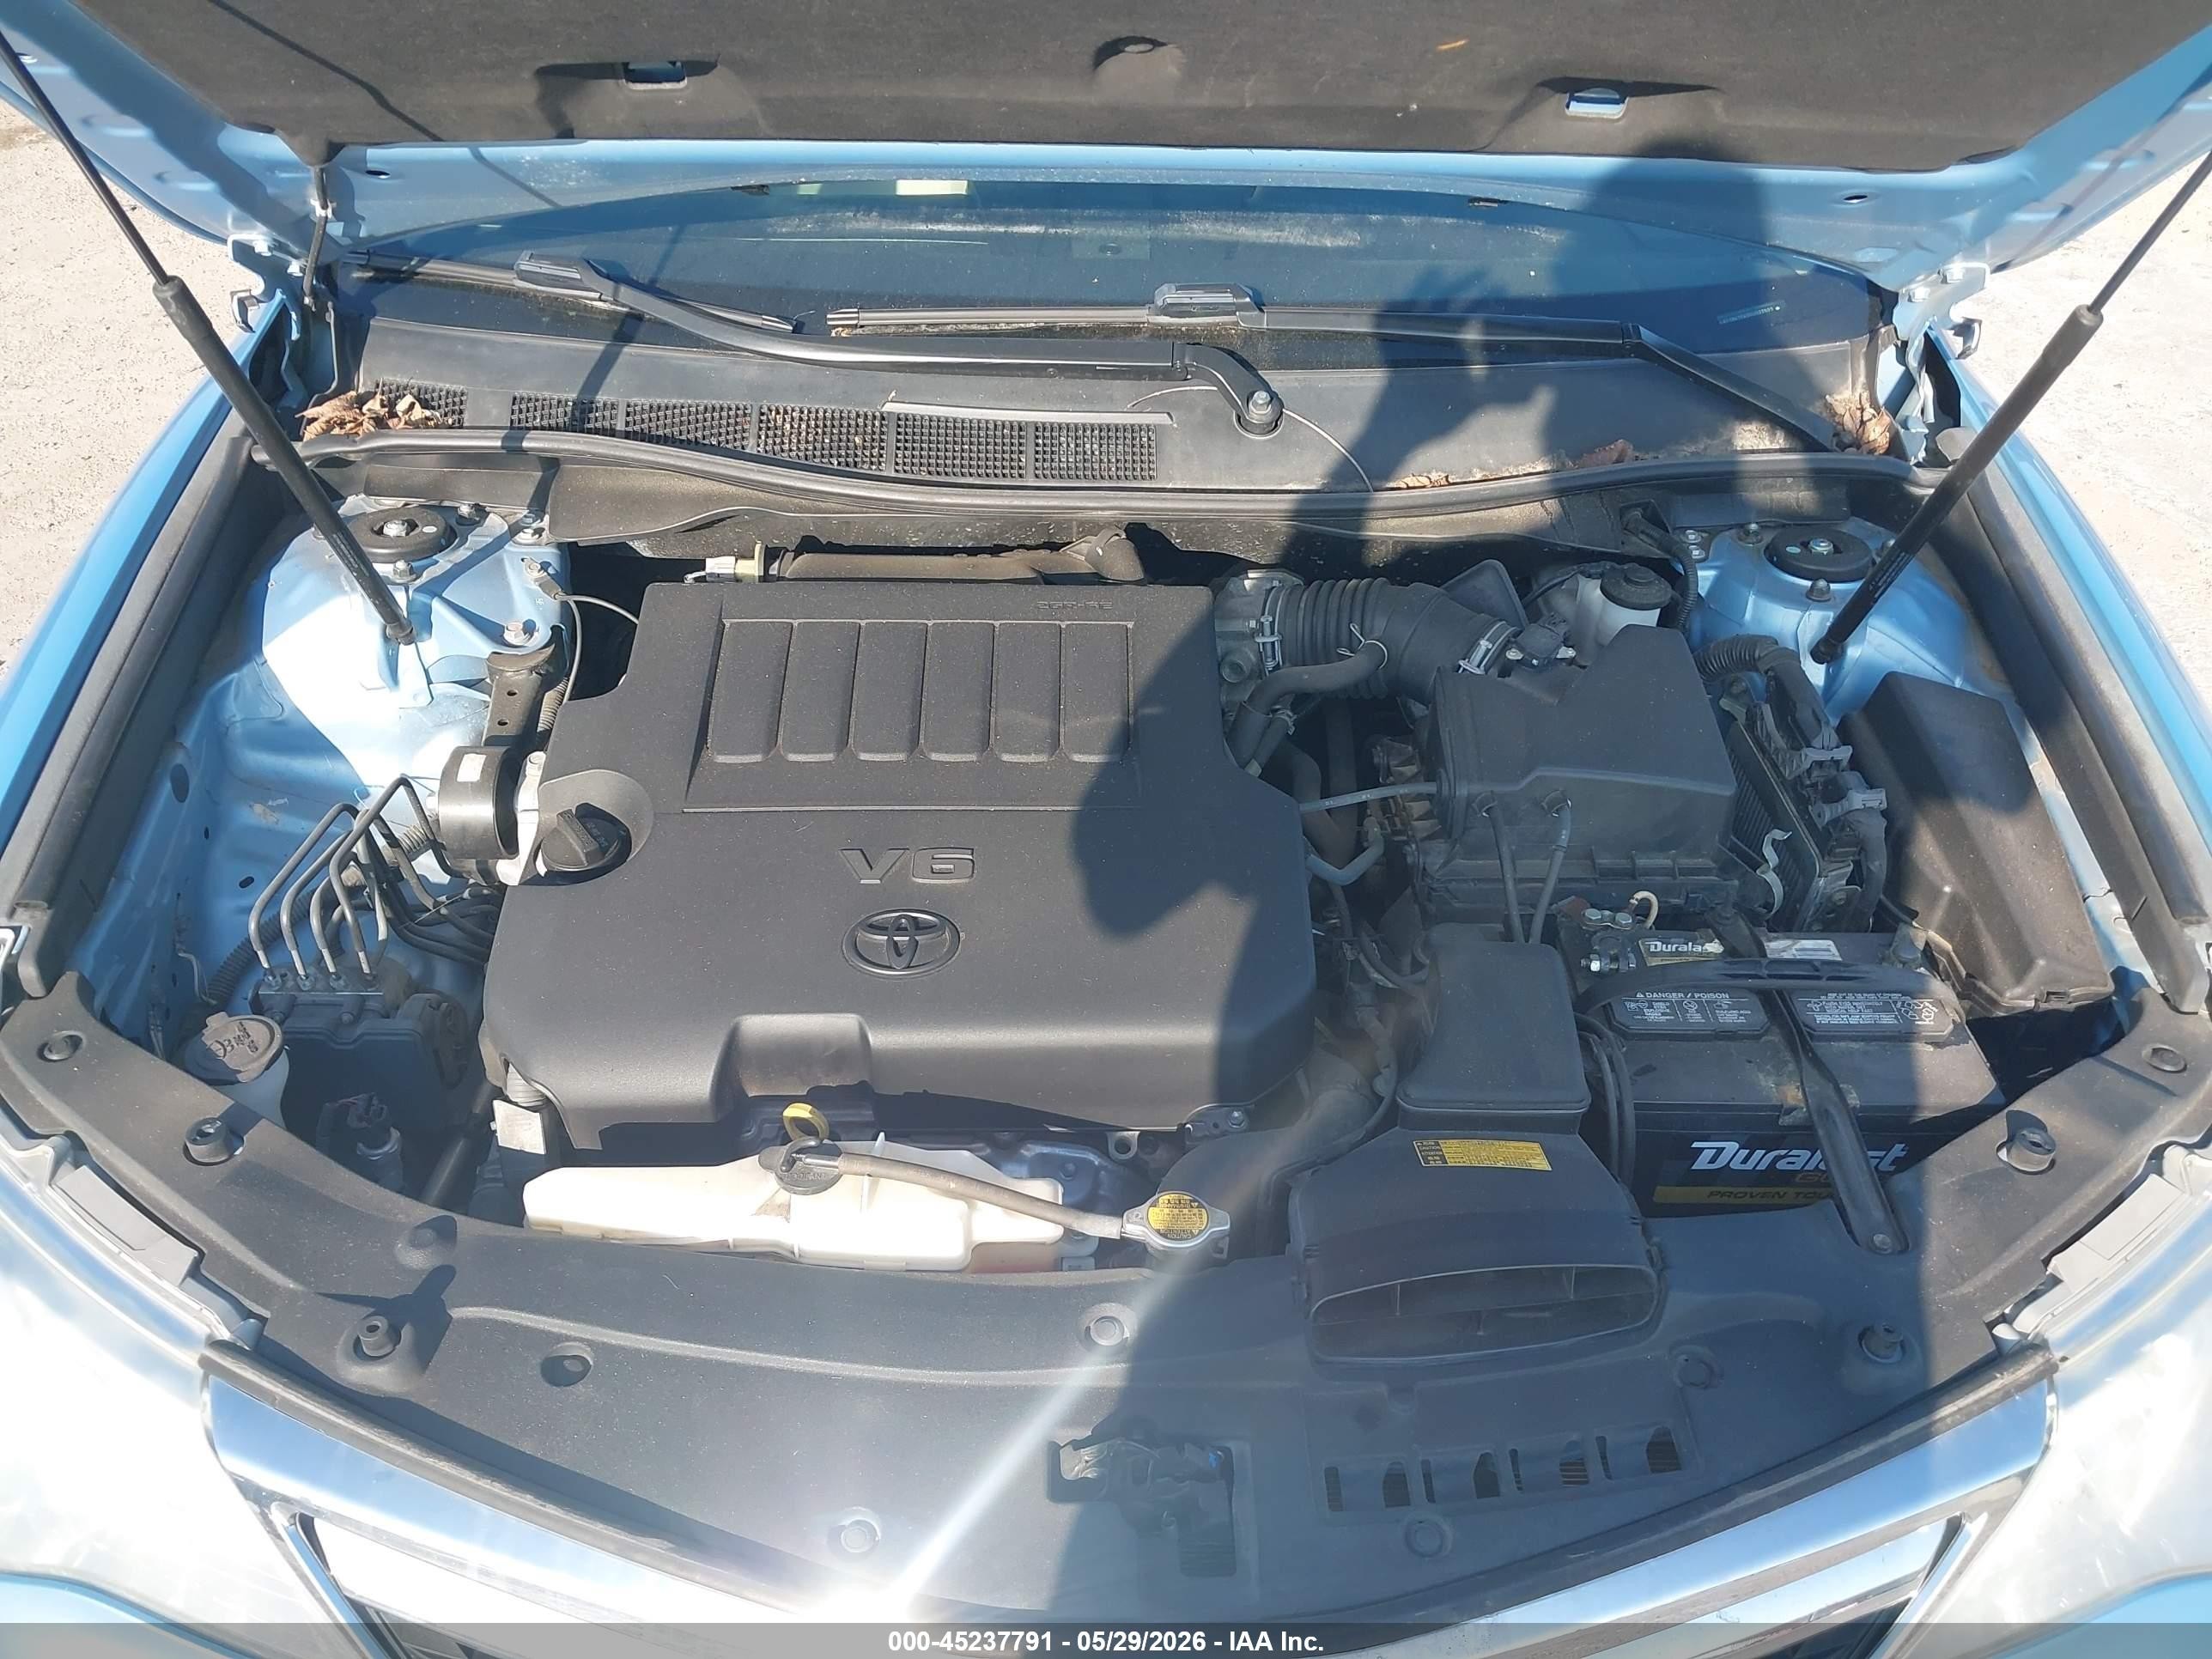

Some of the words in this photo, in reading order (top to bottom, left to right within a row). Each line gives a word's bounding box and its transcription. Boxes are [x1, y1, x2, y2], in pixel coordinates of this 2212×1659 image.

[839, 847, 975, 884] V6
[1644, 941, 1709, 952] Durala
[1707, 1190, 1787, 1200] PROVEN
